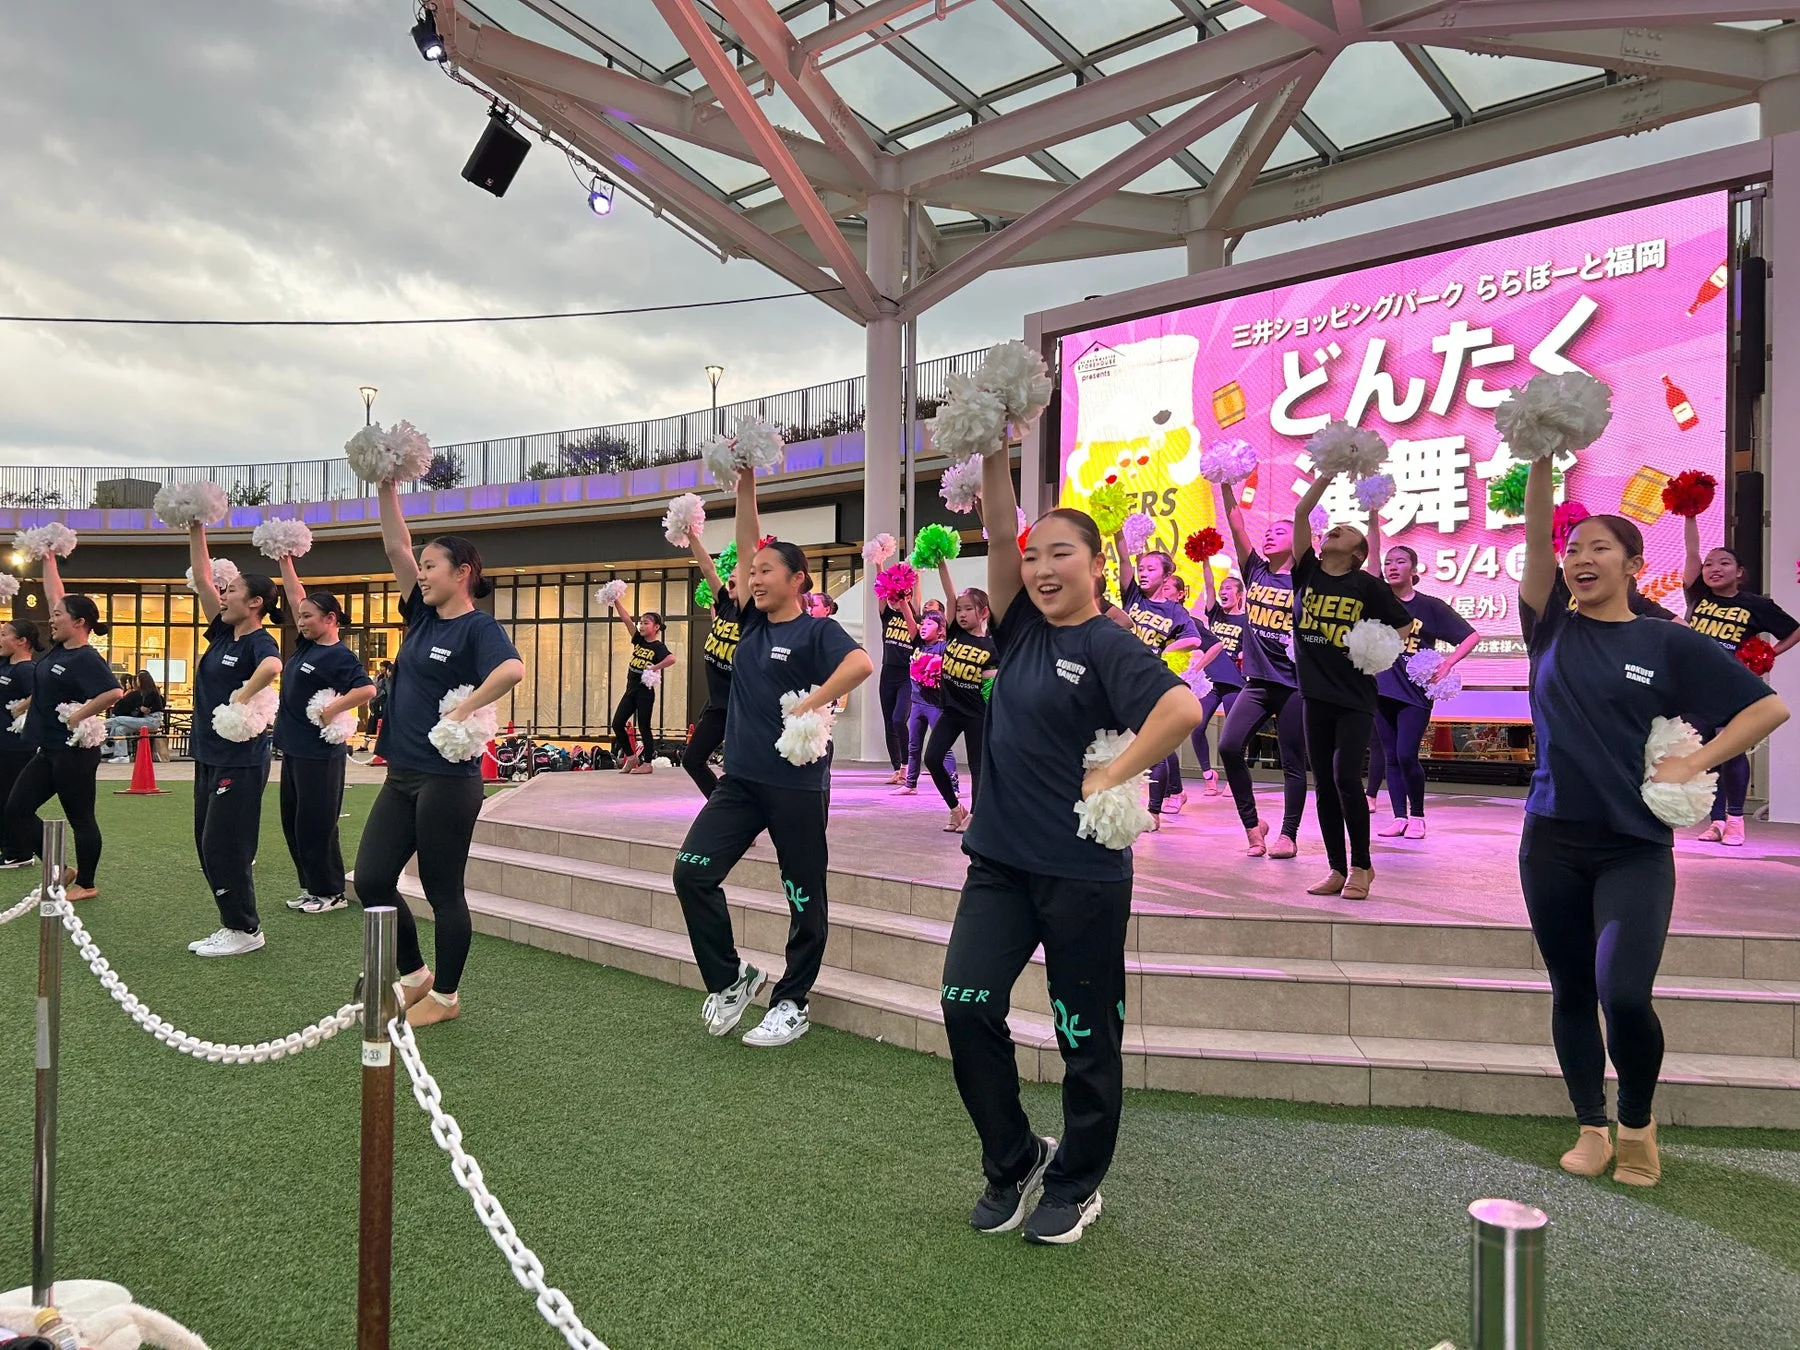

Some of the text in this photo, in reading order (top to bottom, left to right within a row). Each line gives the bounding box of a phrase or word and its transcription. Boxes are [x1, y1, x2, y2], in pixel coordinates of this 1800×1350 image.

[1231, 238, 1666, 350] 三井ショッピングパーク ららぽーと福岡
[1082, 370, 1110, 382] presents
[1269, 294, 1599, 437] どんたく
[1125, 487, 1178, 518] ERS
[1301, 586, 1364, 623] CHEER
[1694, 598, 1751, 625] CHEER
[1298, 607, 1352, 648] DNC
[946, 638, 990, 665] CHEER
[1055, 658, 1087, 675] KOKUFU
[1056, 667, 1080, 685] DANCE
[1624, 663, 1654, 678] KOKUFU
[1625, 671, 1651, 685] DANCE
